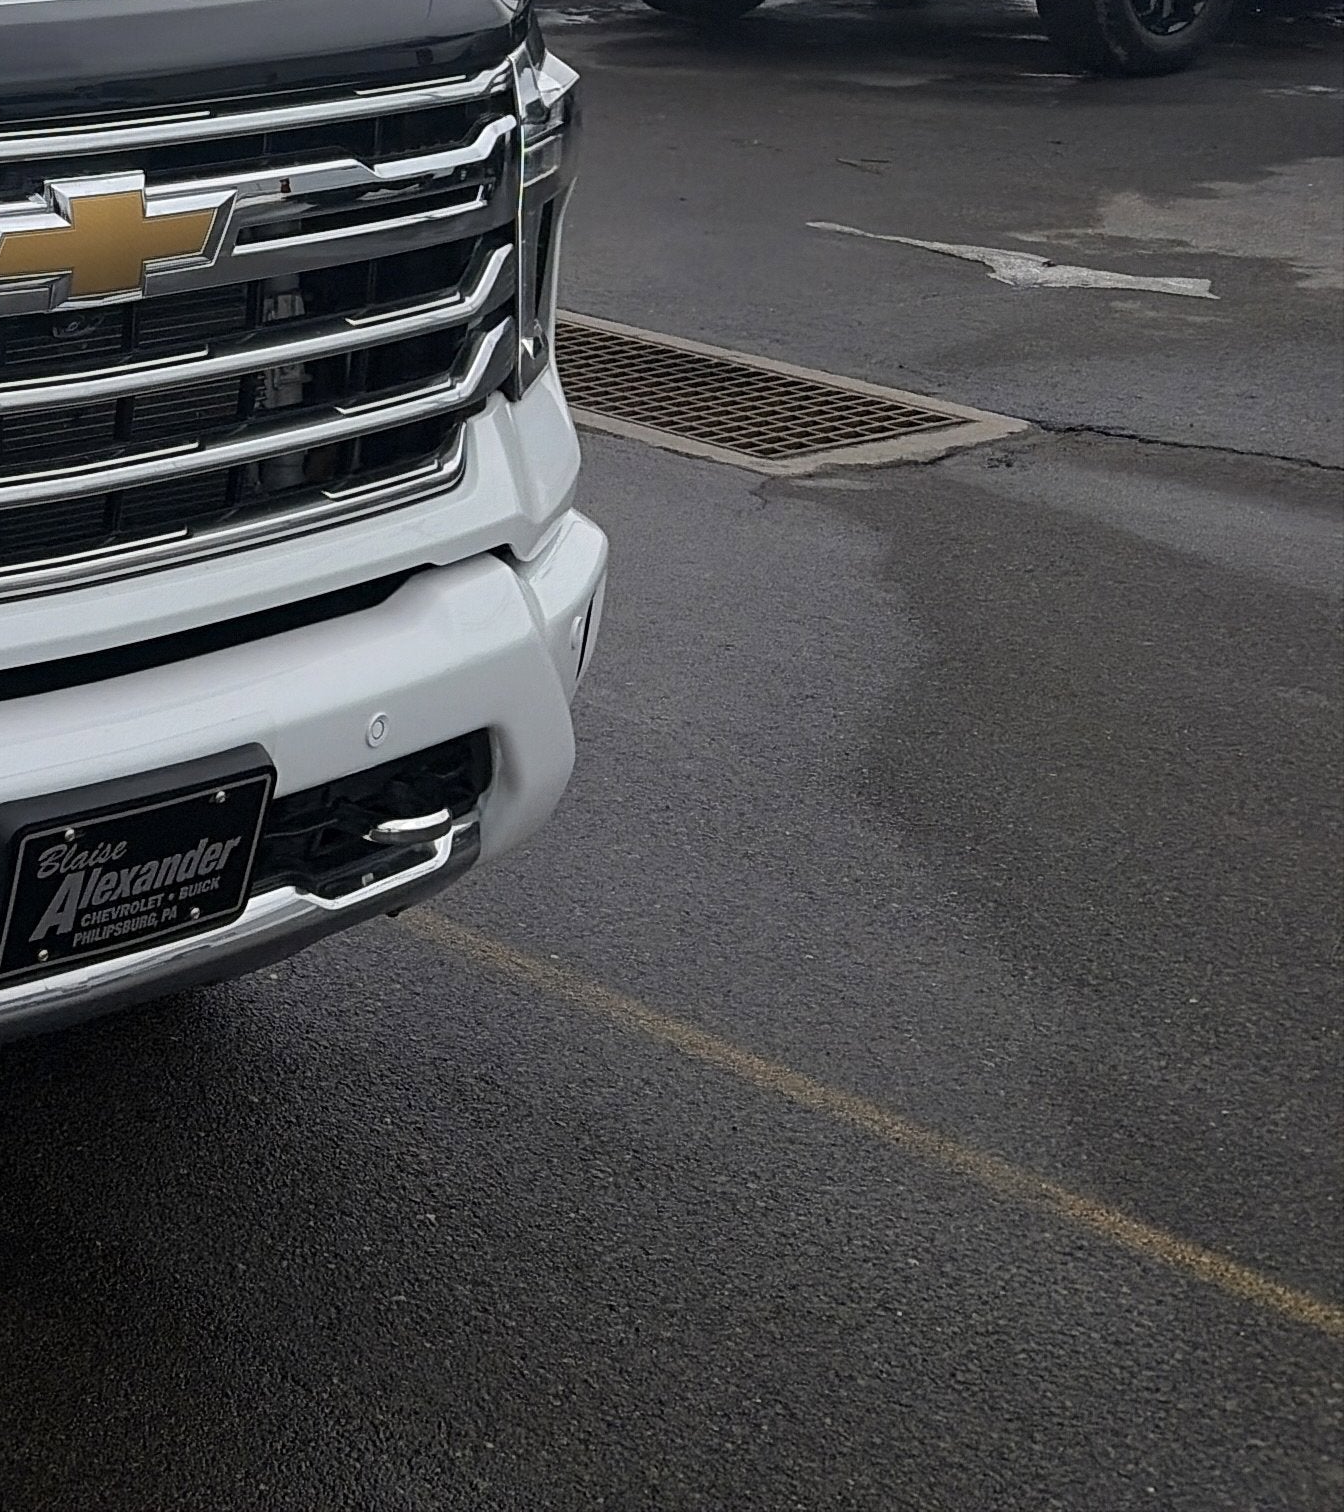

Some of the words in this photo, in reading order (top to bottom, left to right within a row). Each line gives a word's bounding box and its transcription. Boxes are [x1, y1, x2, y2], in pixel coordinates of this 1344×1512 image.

[37, 840, 128, 879] Blaise
[28, 836, 242, 943] Alexander
[80, 893, 165, 928] CHEVROLET
[178, 876, 222, 901] BUICK
[72, 912, 160, 948] PHILIPSBURG,
[161, 905, 178, 923] PA
